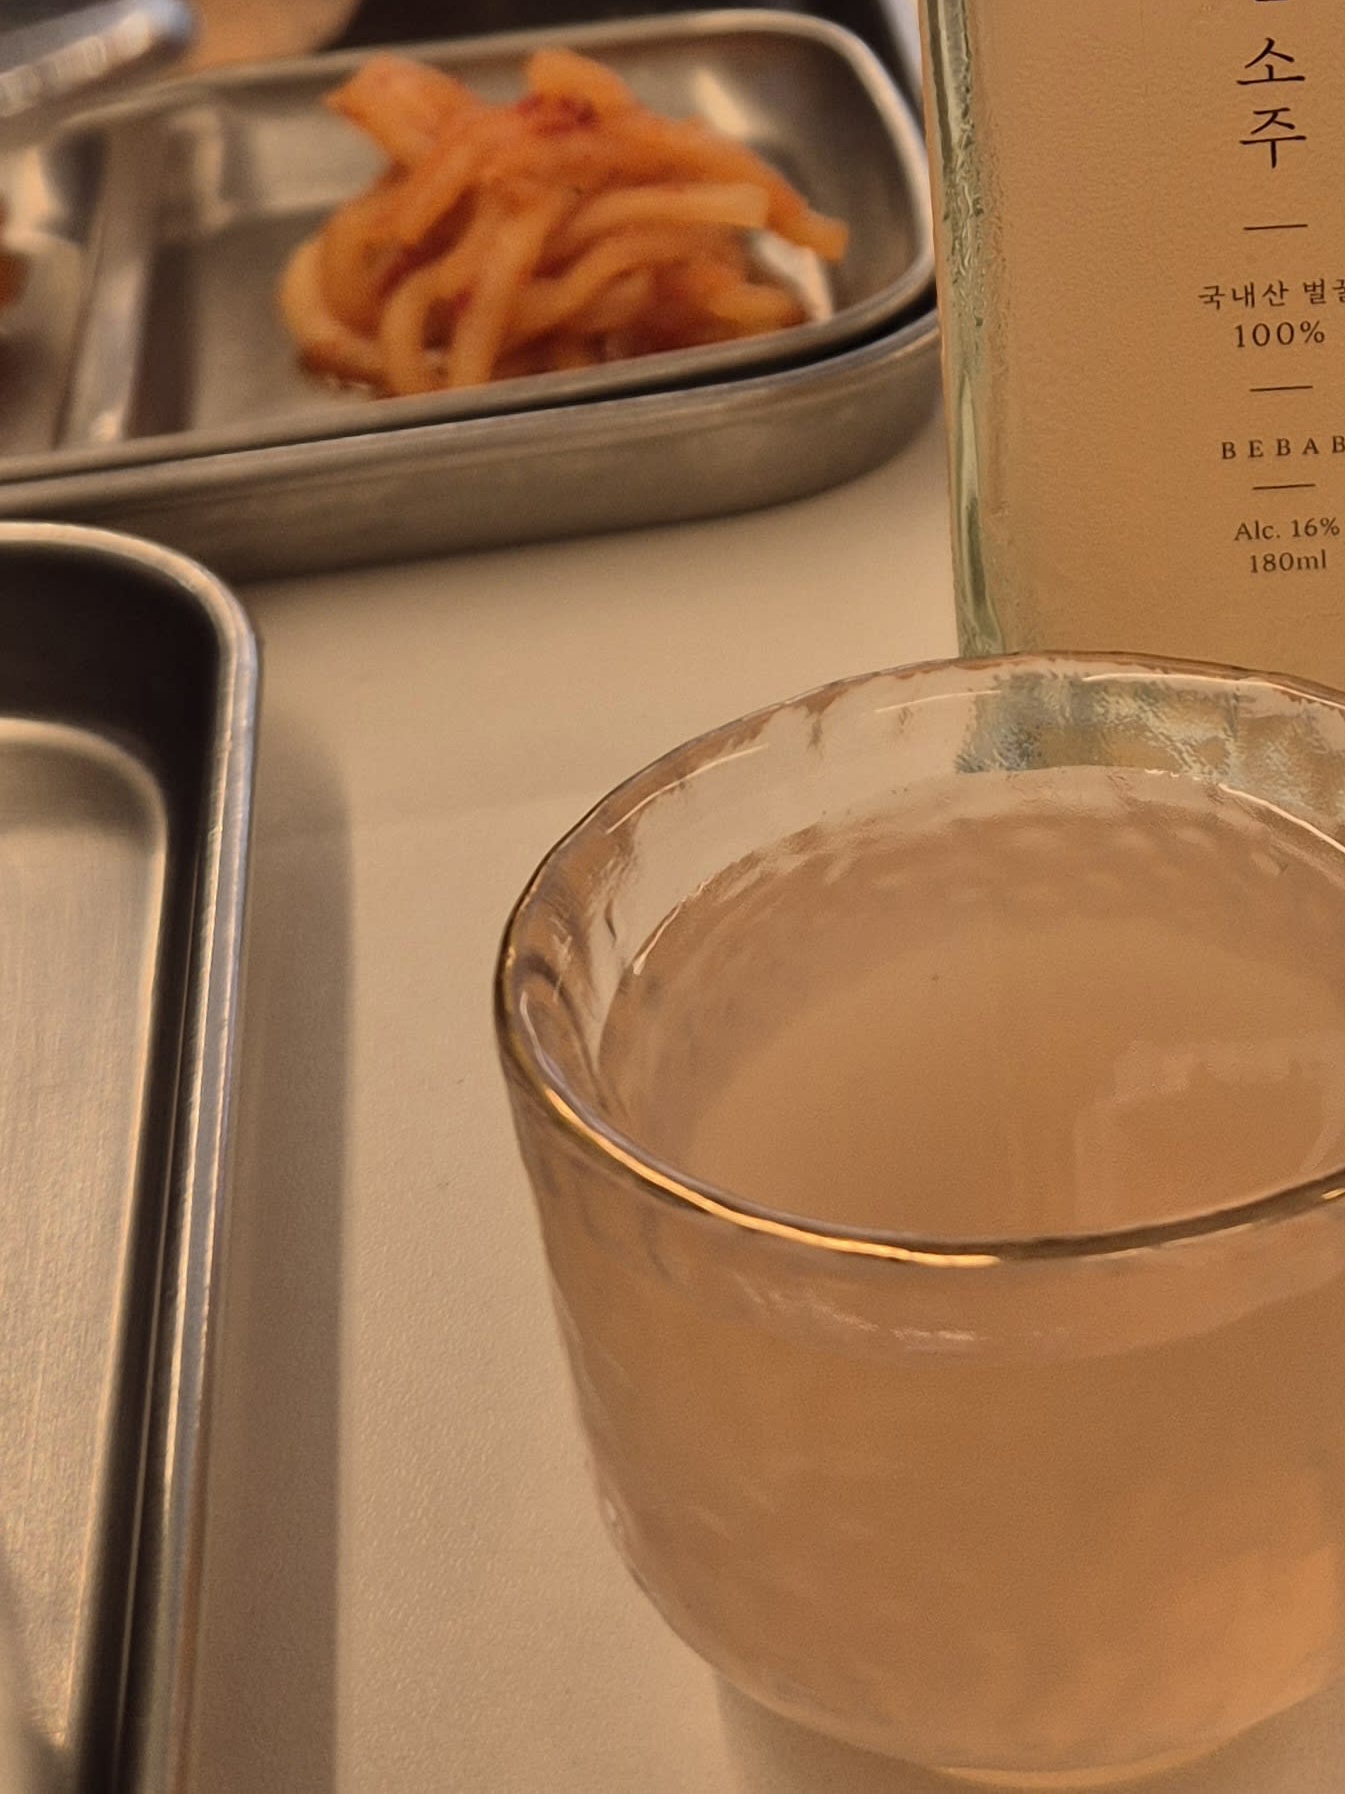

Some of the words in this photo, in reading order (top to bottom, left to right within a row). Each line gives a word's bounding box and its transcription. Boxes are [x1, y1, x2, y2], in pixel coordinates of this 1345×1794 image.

[1199, 281, 1289, 310] 국내산
[1234, 320, 1326, 348] 100%
[1234, 521, 1281, 542] Alc.
[1291, 517, 1341, 538] 16%
[1249, 549, 1327, 574] 180ml
